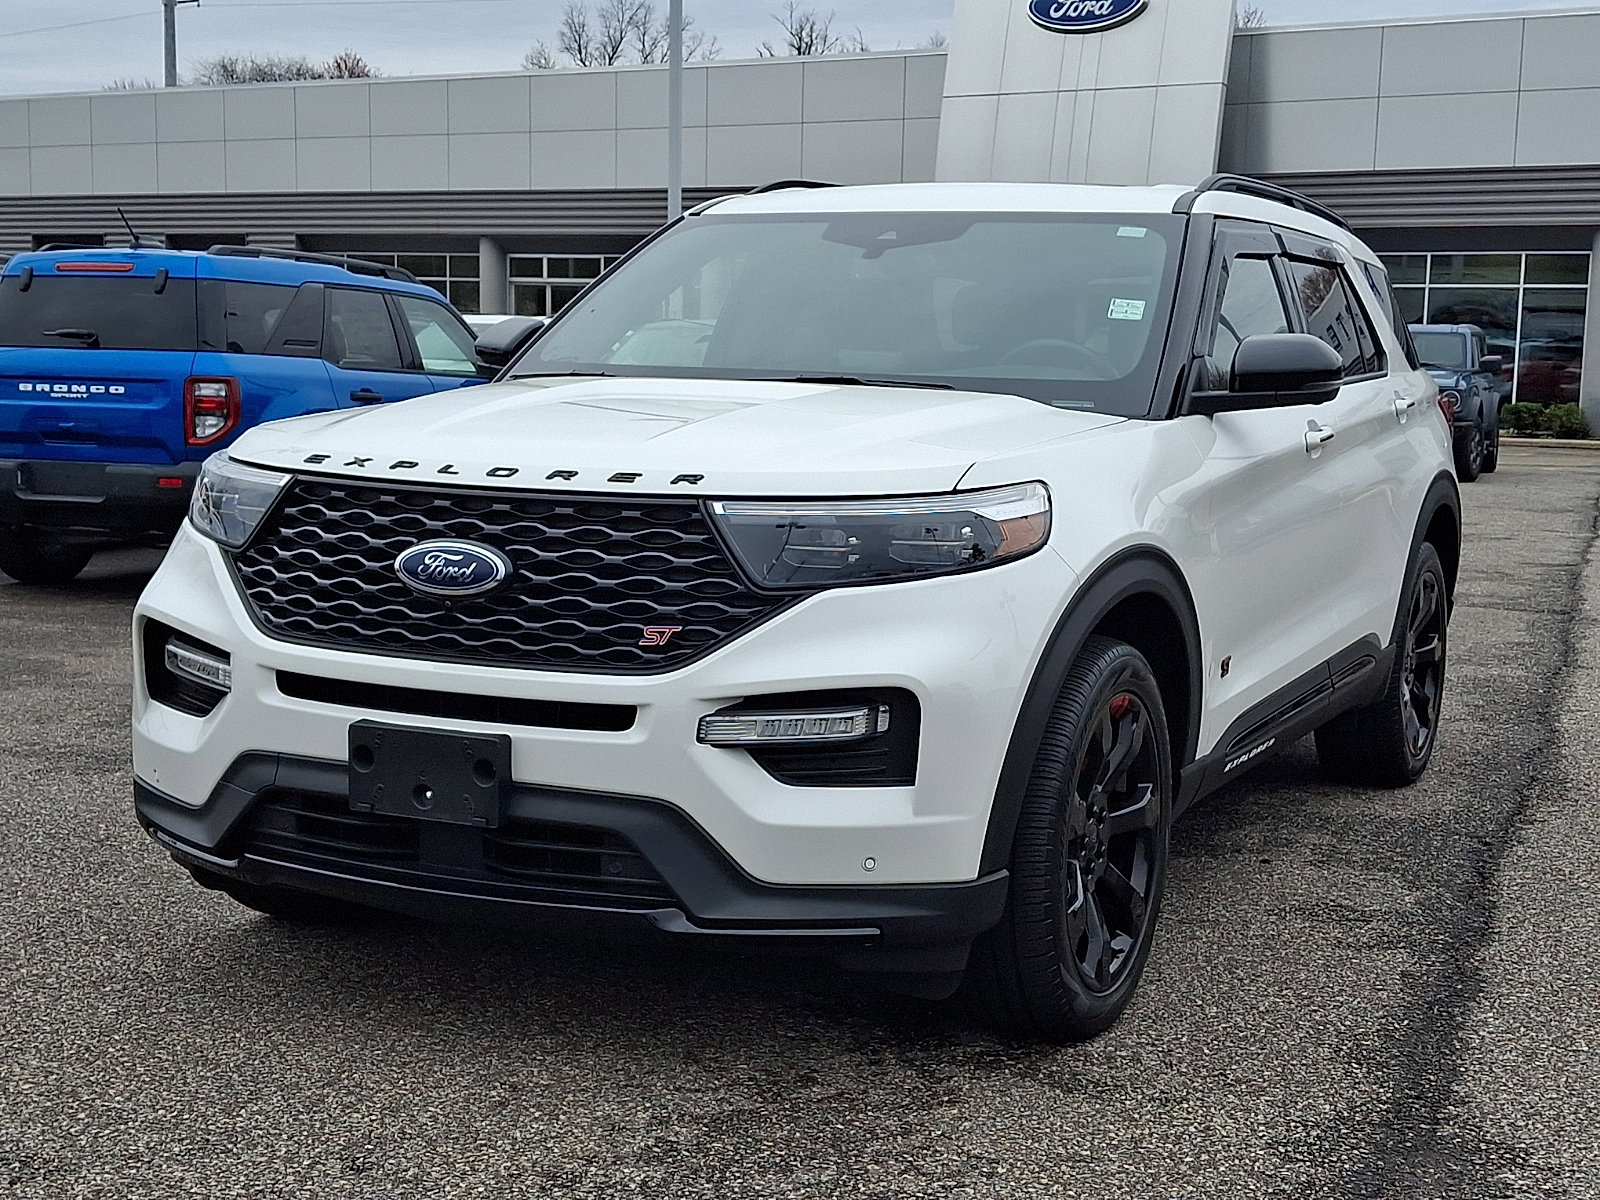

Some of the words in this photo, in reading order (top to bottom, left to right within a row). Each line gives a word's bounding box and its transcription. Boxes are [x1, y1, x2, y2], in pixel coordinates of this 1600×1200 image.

[1050, 0, 1113, 18] Ford
[18, 383, 125, 394] BRONCO
[303, 453, 706, 486] EXPLORER
[416, 551, 476, 584] Ford
[639, 626, 682, 645] ST
